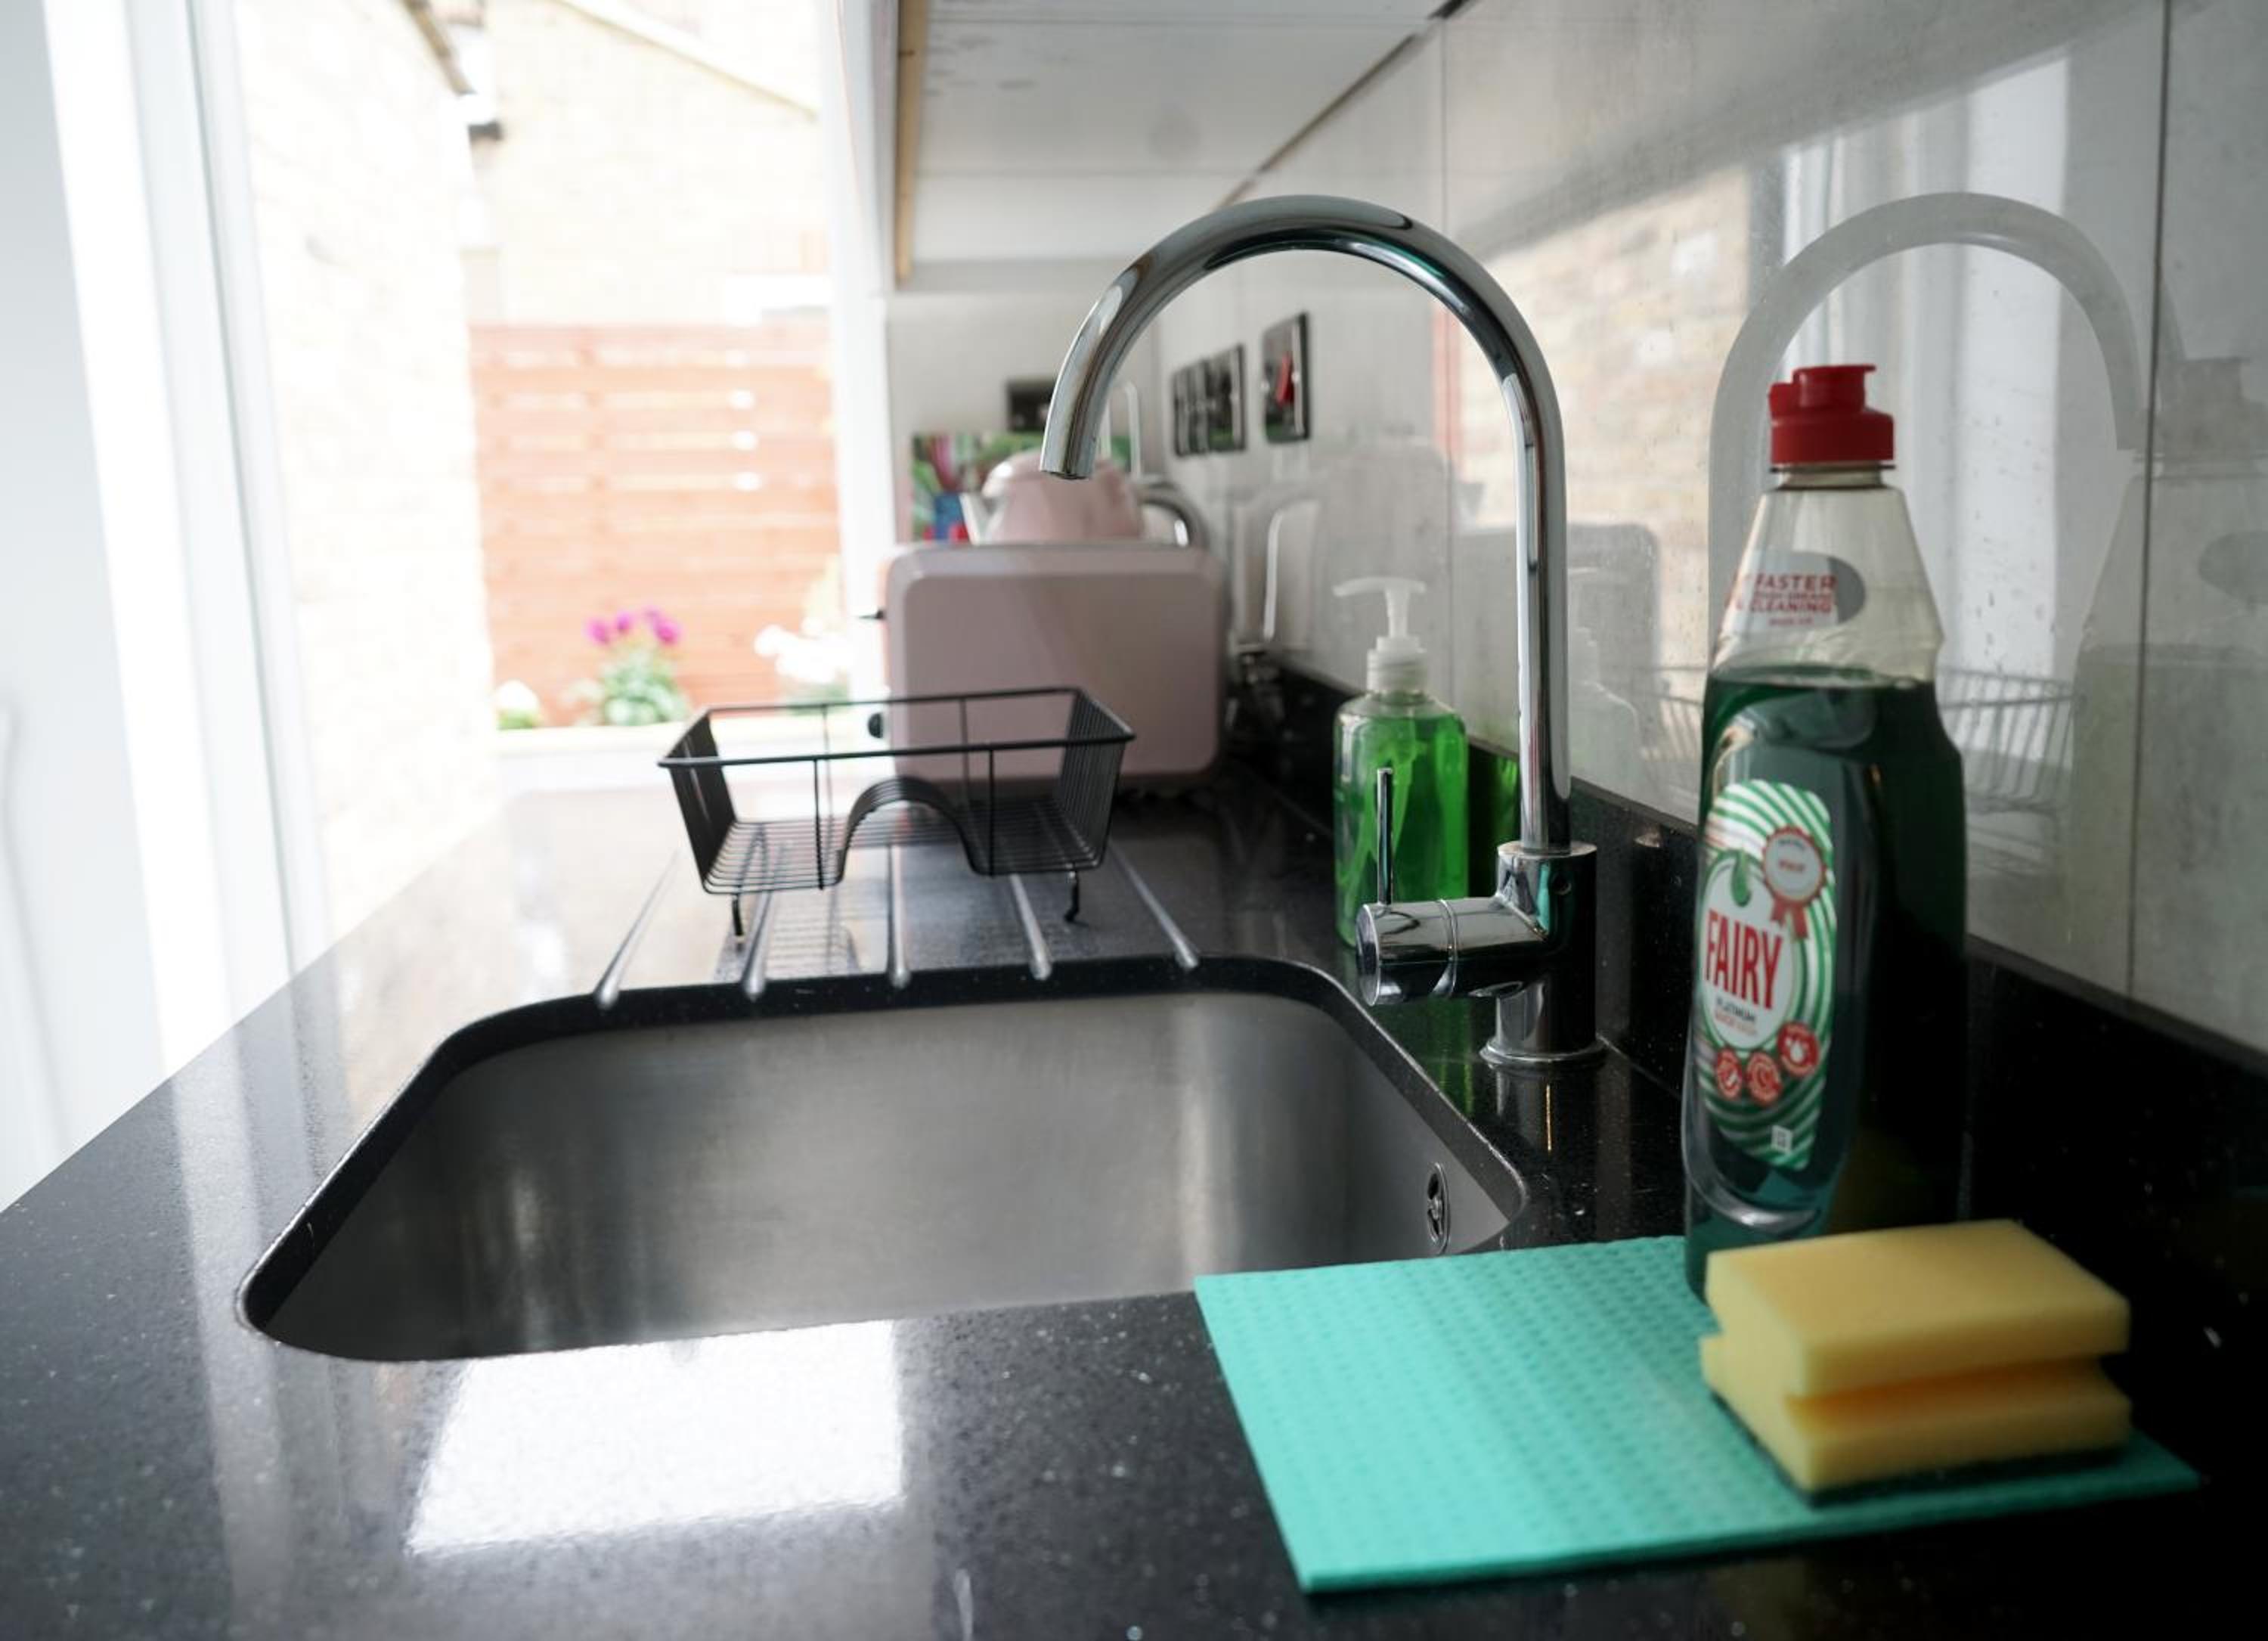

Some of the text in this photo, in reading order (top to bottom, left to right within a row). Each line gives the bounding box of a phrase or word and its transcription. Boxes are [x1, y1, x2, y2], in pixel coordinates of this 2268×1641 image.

[1755, 573, 1838, 591] FASTER
[1750, 598, 1833, 614] CLEANING
[1705, 908, 1783, 1009] FAIRY
